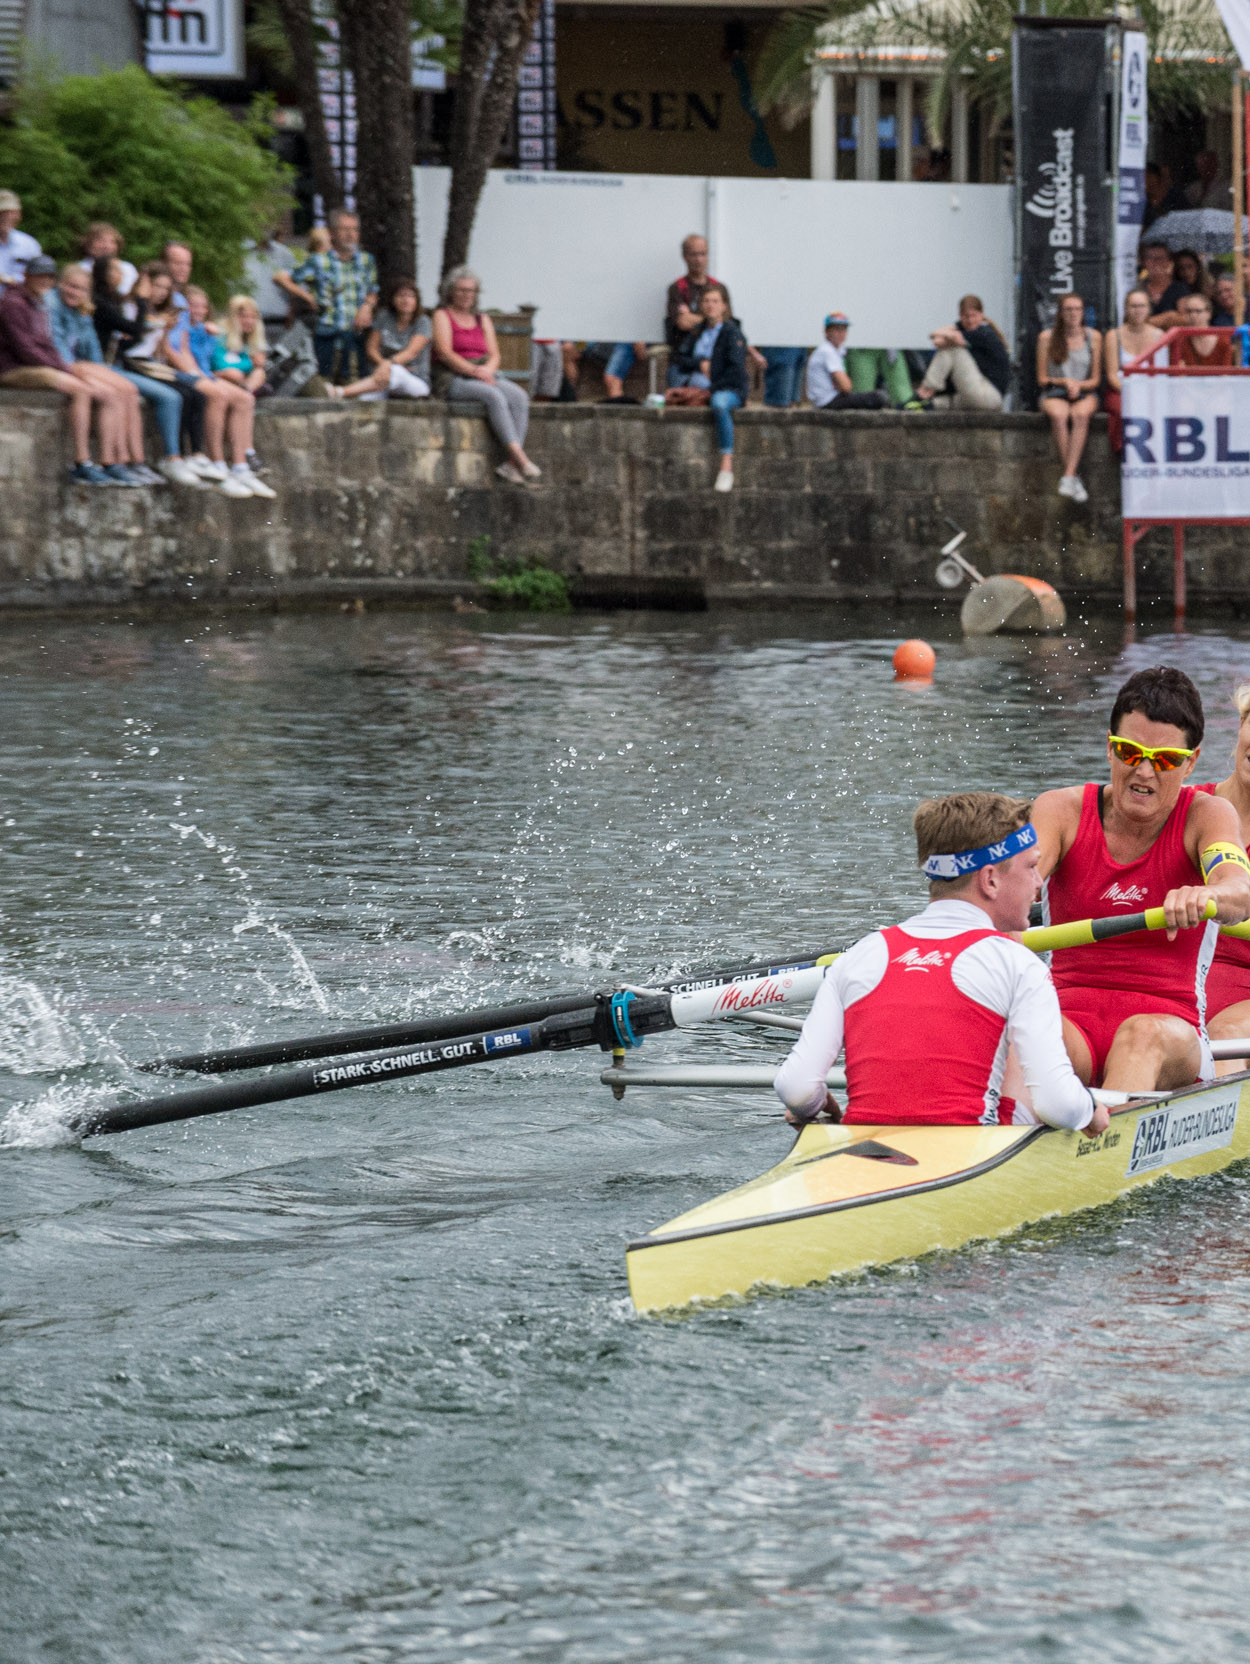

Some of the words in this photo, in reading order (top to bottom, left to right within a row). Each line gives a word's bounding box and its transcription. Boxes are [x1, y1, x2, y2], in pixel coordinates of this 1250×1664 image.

[1049, 127, 1075, 247] Broadcast
[1050, 248, 1073, 294] Live
[988, 841, 1010, 860] NK
[1016, 828, 1035, 847] NK
[1100, 882, 1143, 901] Melitta
[891, 947, 945, 966] Melitta
[712, 979, 790, 1015] Melitta
[494, 1032, 522, 1047] RBL
[319, 1062, 370, 1083] STARK.
[371, 1049, 441, 1073] SCHNELL.
[443, 1042, 476, 1060] GUT.
[1143, 1112, 1170, 1156] RBL
